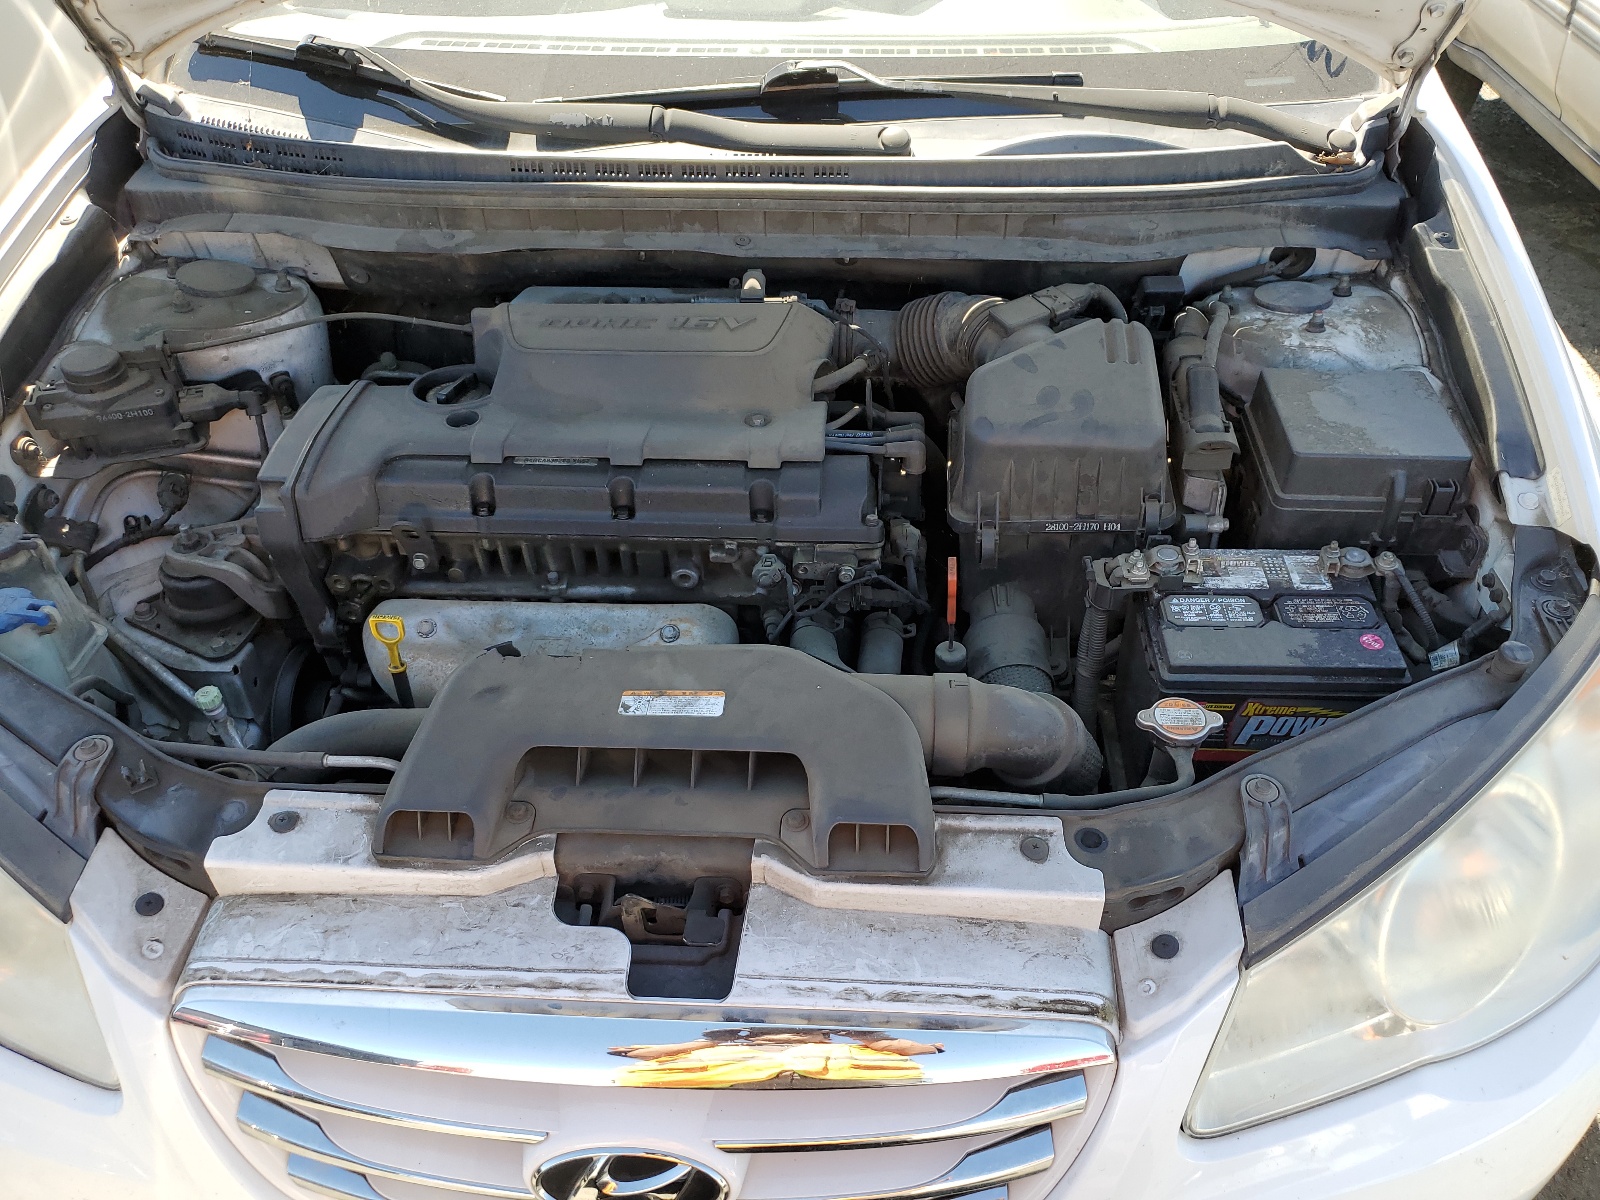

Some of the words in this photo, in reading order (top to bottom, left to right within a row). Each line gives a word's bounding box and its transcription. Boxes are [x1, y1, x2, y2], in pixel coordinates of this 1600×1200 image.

[667, 315, 758, 331] 16V
[1045, 522, 1100, 531] 28100-2H170
[1103, 522, 1121, 531] H04
[1241, 702, 1297, 716] Xtreme
[1233, 715, 1338, 745] pow
